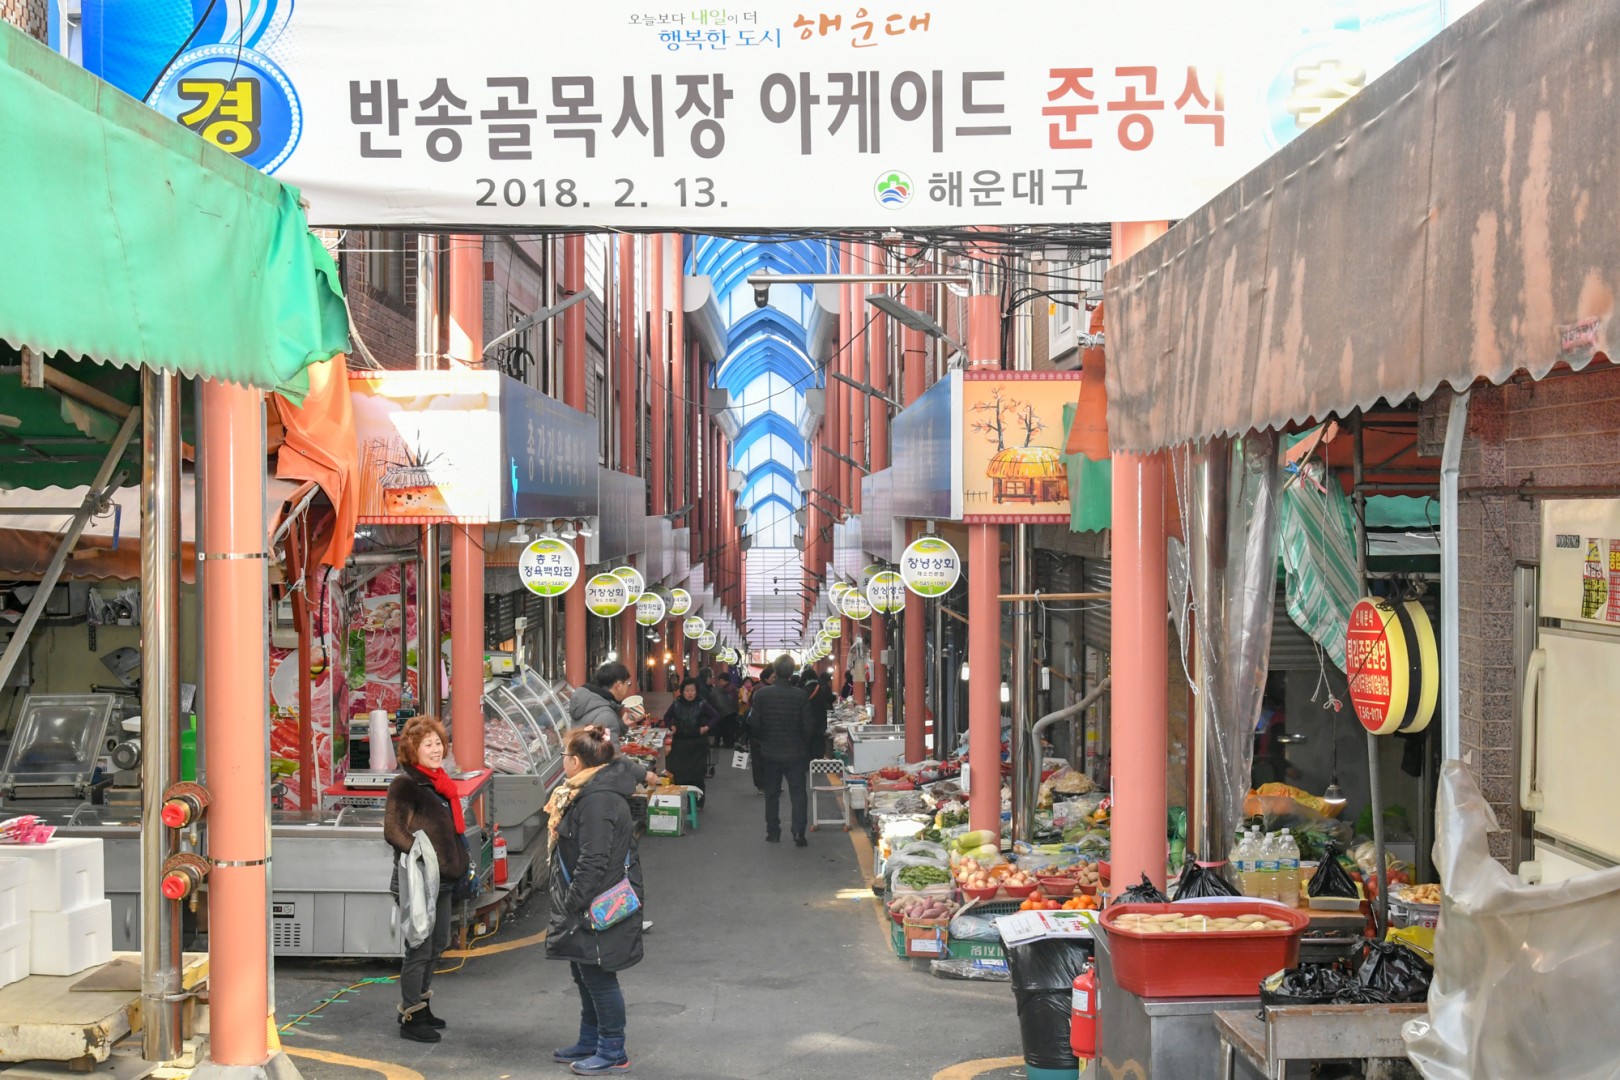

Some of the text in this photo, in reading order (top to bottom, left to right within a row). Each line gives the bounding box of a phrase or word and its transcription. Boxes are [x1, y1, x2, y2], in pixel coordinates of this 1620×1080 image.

[627, 9, 758, 27] 오늘보다 내일이 더
[793, 7, 931, 48] 해운대
[657, 28, 781, 51] 행복한 도시
[179, 79, 258, 156] 경
[348, 65, 1226, 162] 반송골목시장 아케이드 준공식
[475, 178, 729, 208] 2018. 2. 13.
[927, 169, 1089, 208] 해운대구
[524, 565, 573, 578] 정육백화점
[907, 557, 955, 570] 창녕상회
